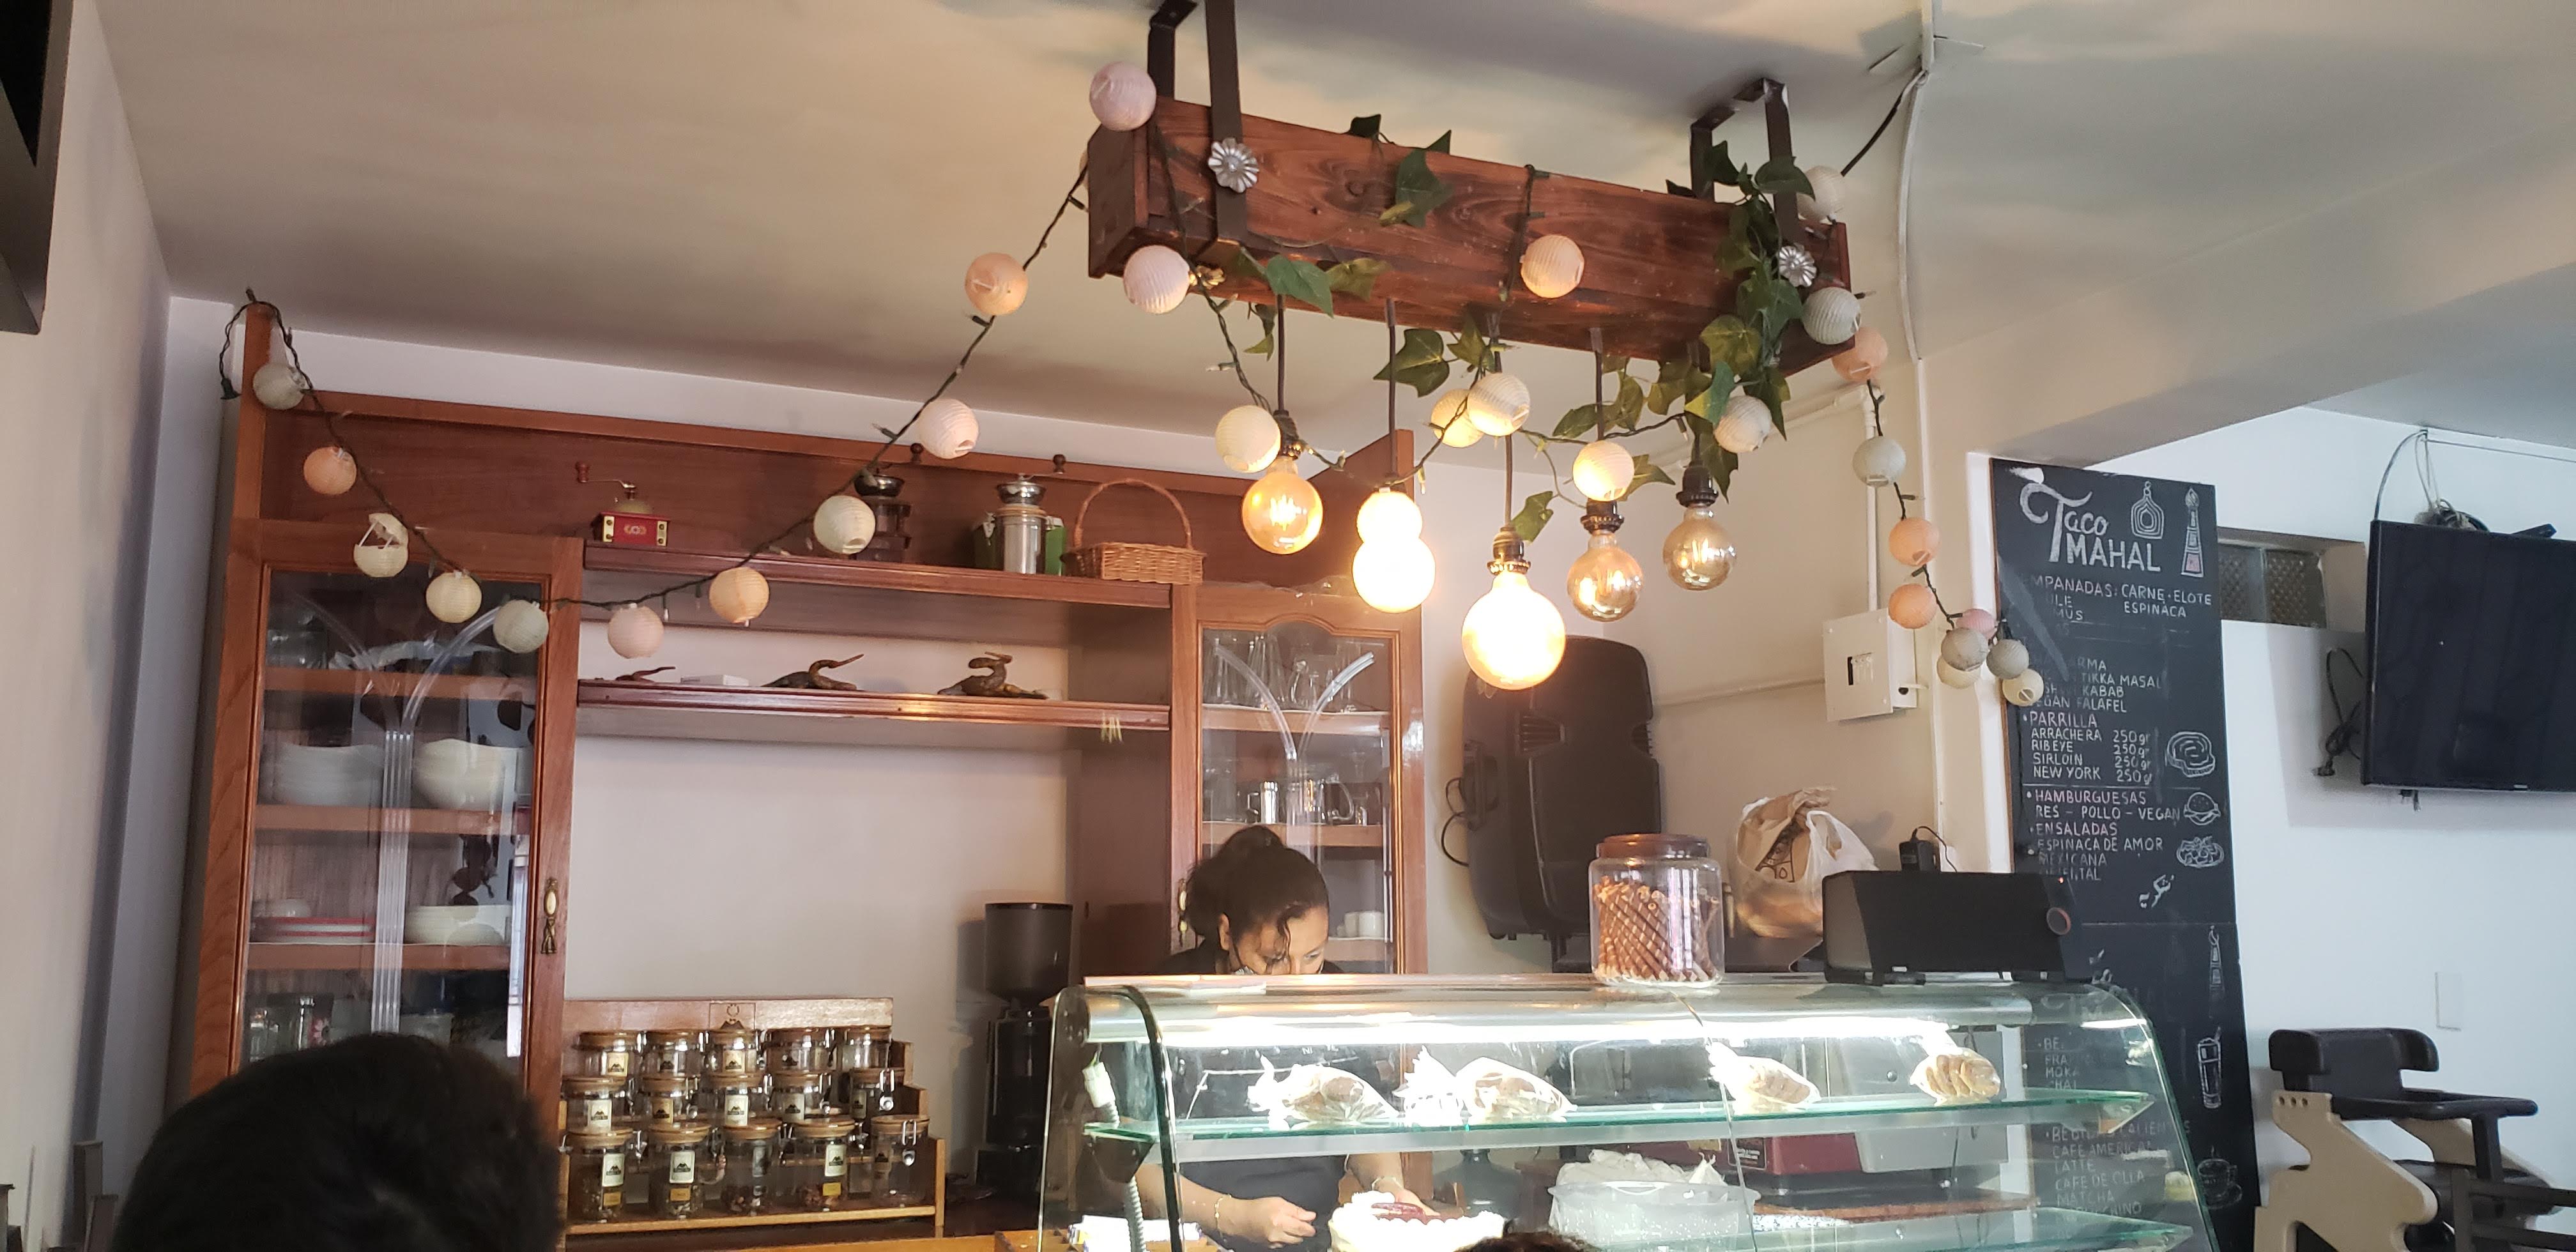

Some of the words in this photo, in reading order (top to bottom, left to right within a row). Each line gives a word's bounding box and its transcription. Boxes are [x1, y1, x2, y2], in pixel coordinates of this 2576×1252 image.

[2020, 482, 2109, 563] Taco
[2066, 533, 2161, 572] MAHAL
[2033, 574, 2118, 598] MPANADAS:
[2121, 584, 2165, 601] CARNE
[2174, 590, 2211, 605] ELOTE
[2124, 601, 2186, 618] ESPINACA
[2081, 672, 2115, 685] TIKKA
[2119, 675, 2161, 689] MASAL
[2082, 685, 2125, 698] KABAB
[2077, 697, 2127, 714] FALAFEL
[2030, 710, 2097, 728] PARRILLA
[2031, 727, 2103, 742] ARRACHERA
[2032, 752, 2083, 767] SIRLOIN
[2034, 765, 2063, 779] NEW
[2066, 766, 2102, 781] YORK
[2035, 790, 2147, 805] HAMBURGUESAS
[2035, 805, 2060, 818] RES
[2081, 805, 2121, 820] POLLO
[2036, 821, 2118, 836] ENSALADAS
[2103, 836, 2119, 852] DE
[2124, 837, 2163, 851] AMOR
